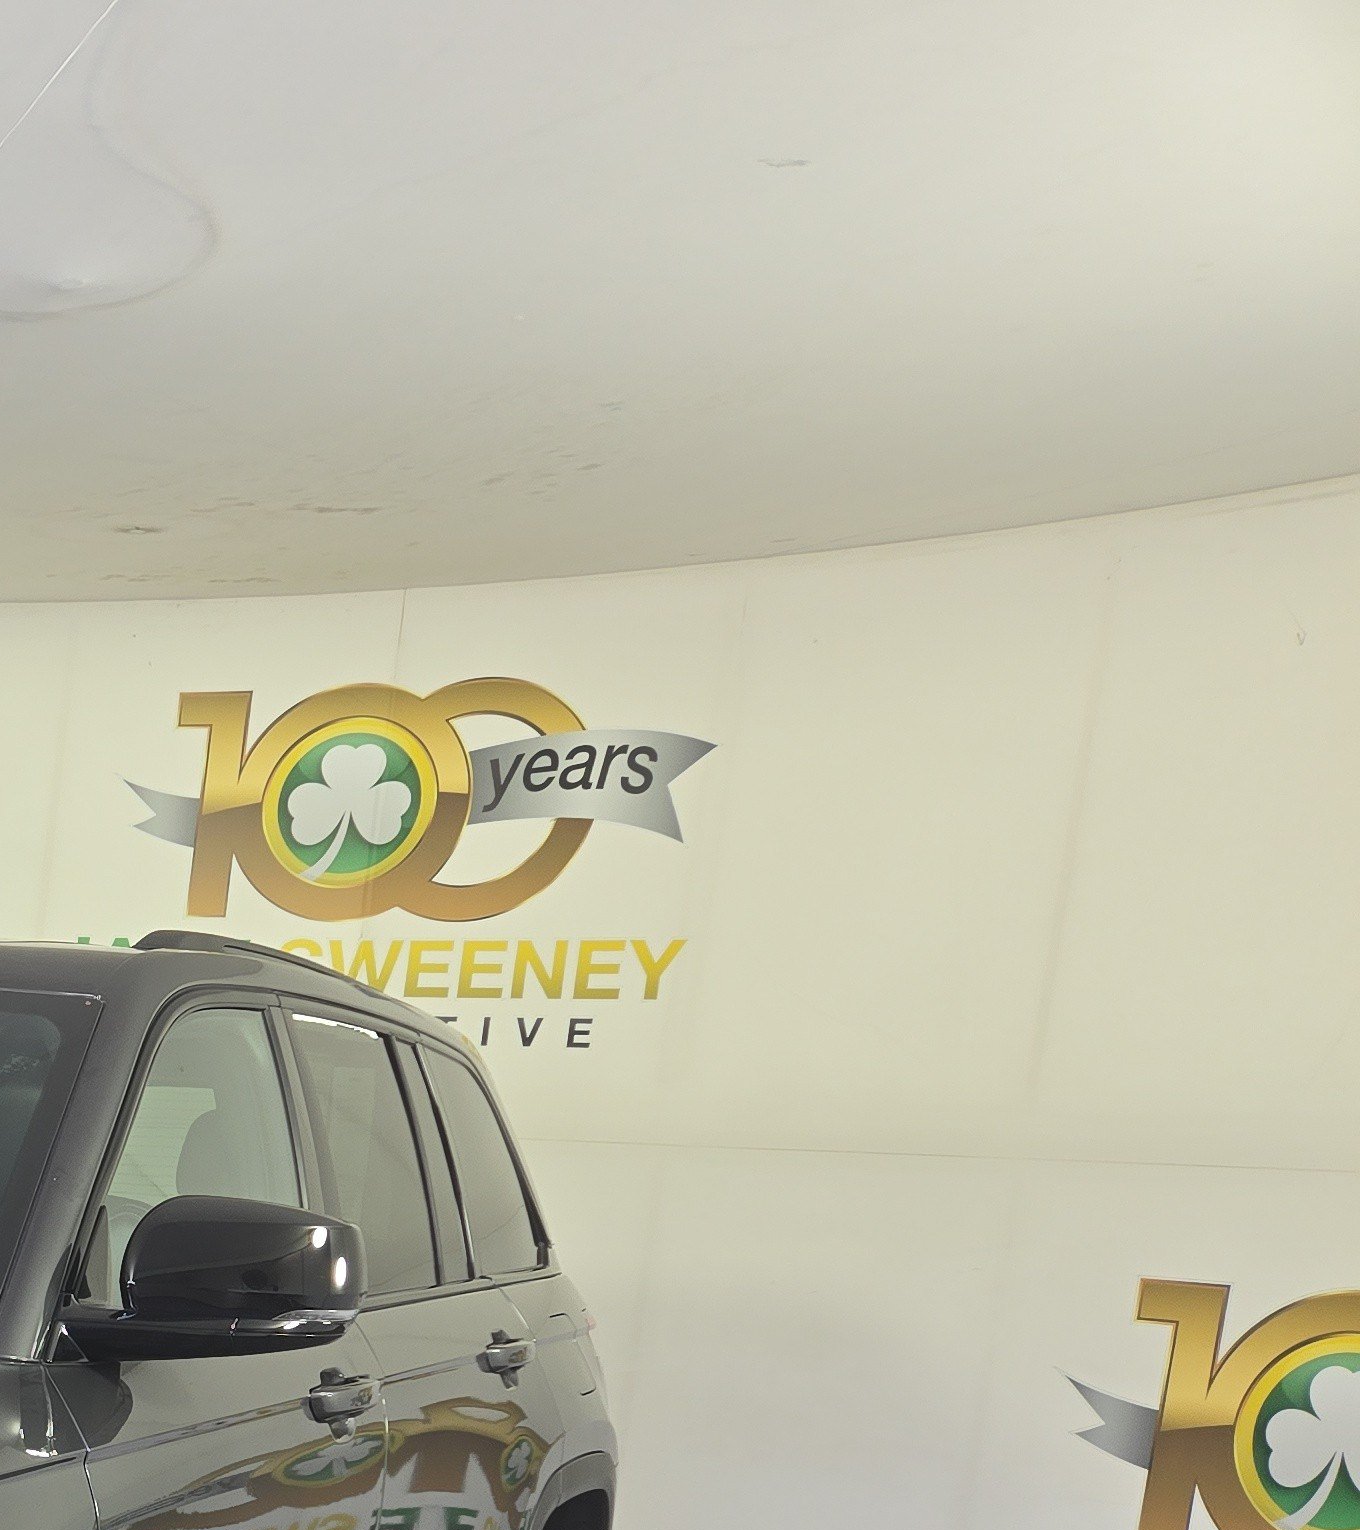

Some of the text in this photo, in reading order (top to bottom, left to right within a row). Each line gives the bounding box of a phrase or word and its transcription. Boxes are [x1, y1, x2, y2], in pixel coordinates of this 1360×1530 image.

[178, 677, 593, 922] 100
[482, 742, 658, 812] years
[281, 938, 689, 1000] WEENEY
